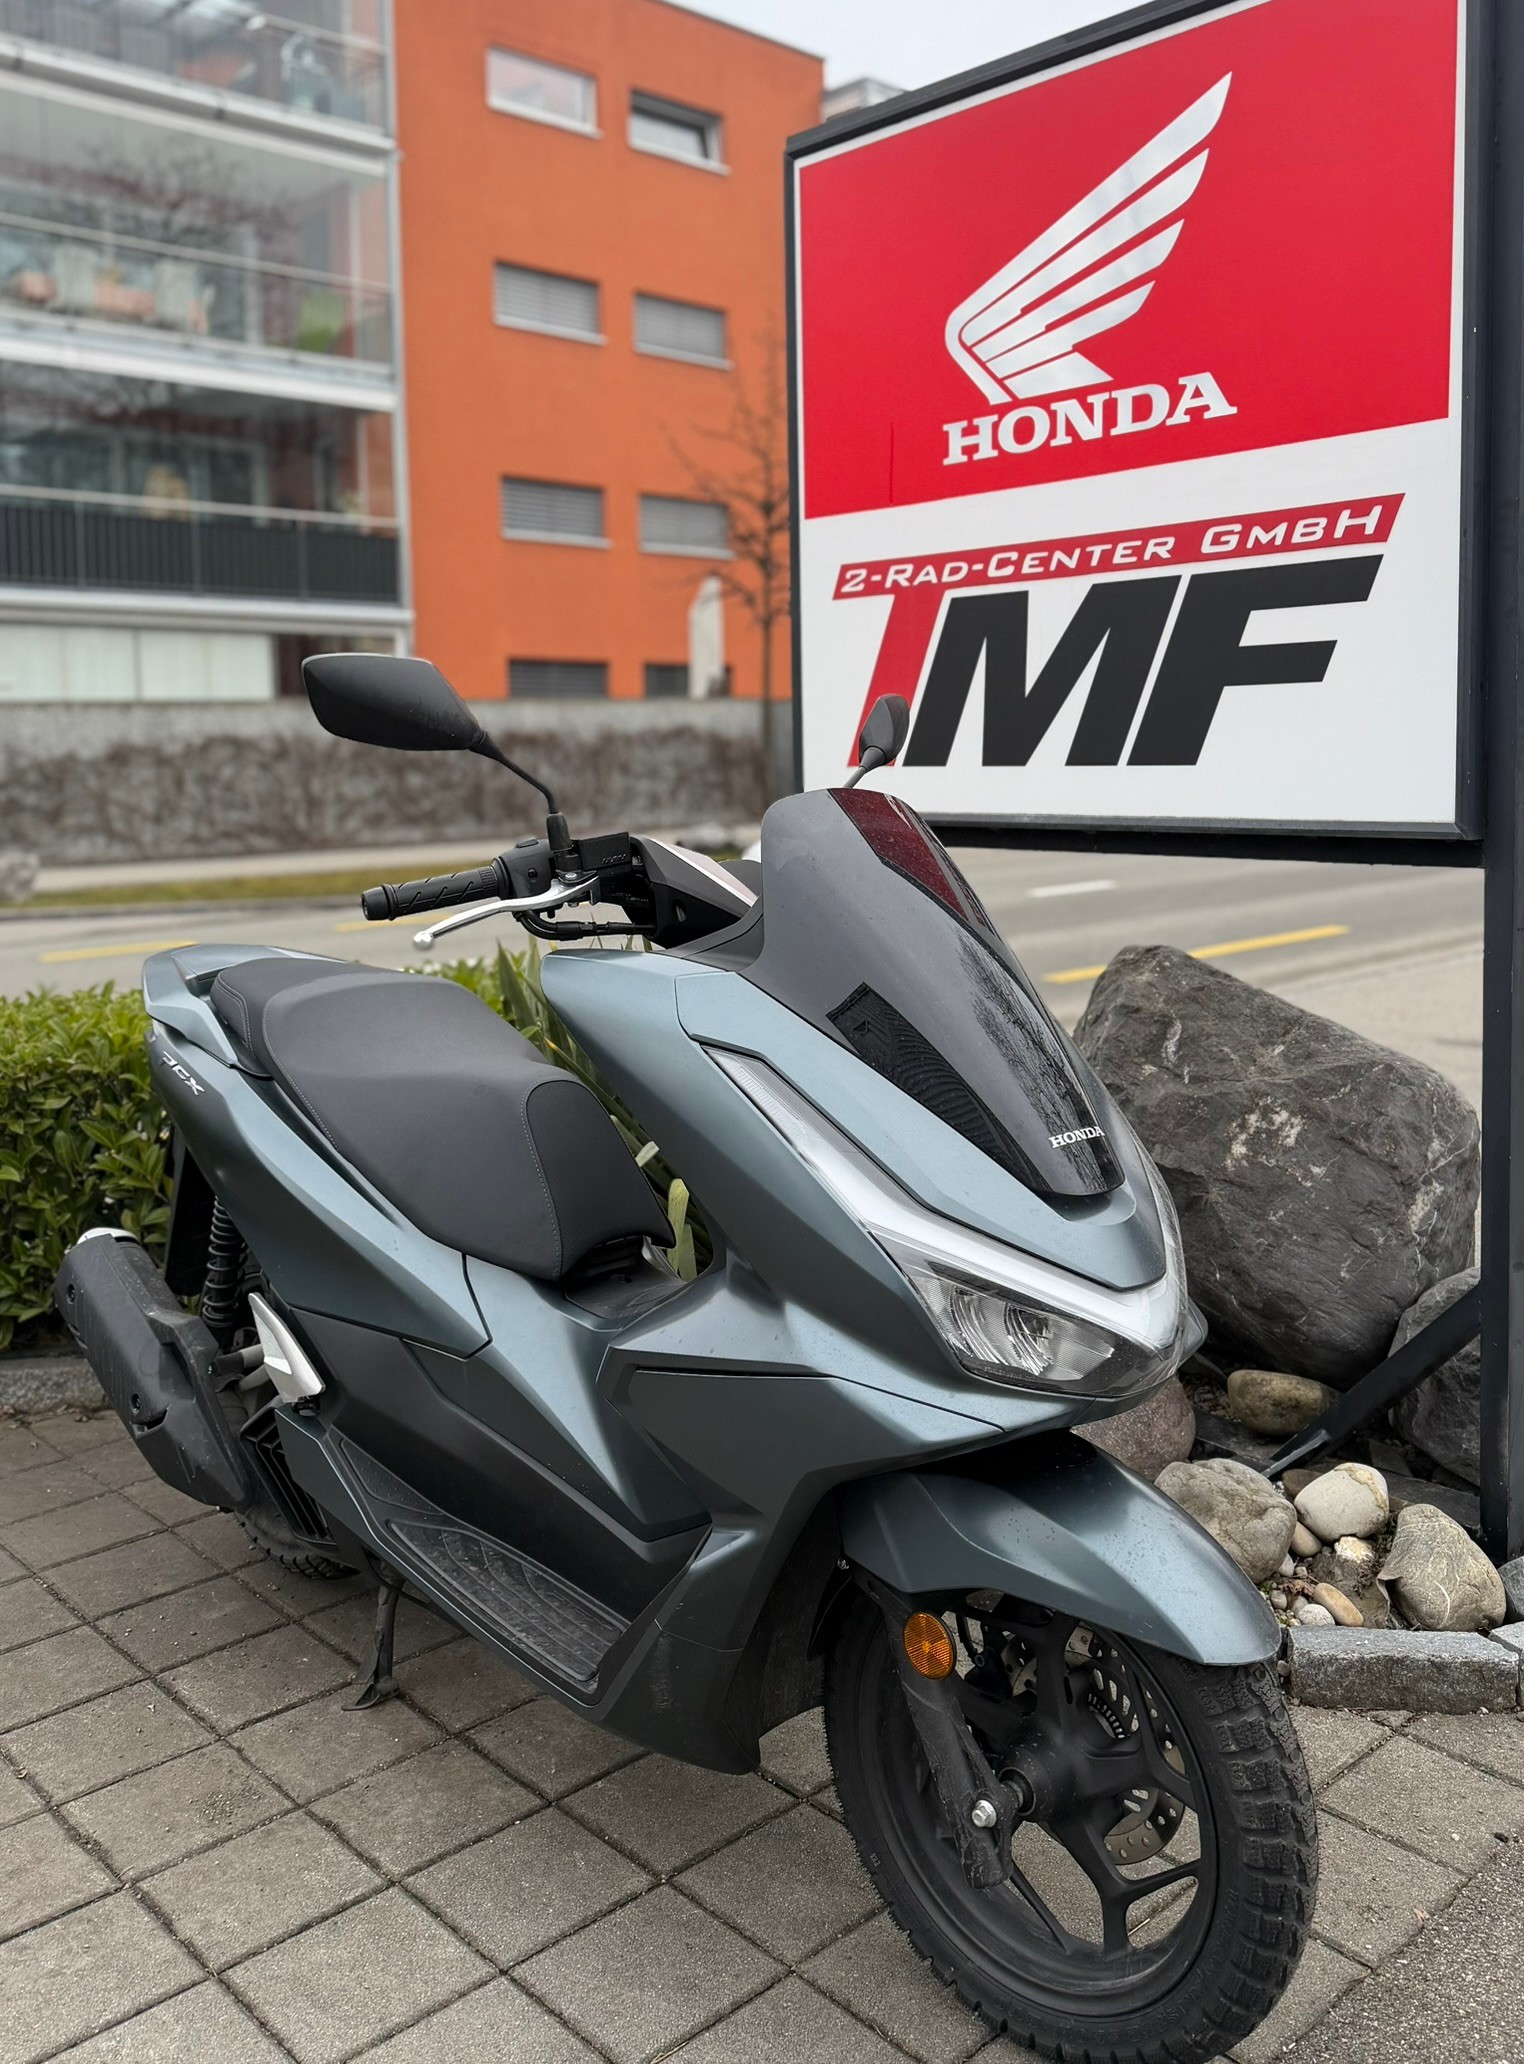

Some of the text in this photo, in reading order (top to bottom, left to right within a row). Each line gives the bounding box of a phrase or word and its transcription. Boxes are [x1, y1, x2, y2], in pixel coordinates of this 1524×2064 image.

[942, 371, 1238, 466] HONDA
[833, 553, 1384, 767] TMF
[1048, 1126, 1106, 1149] HONDA
